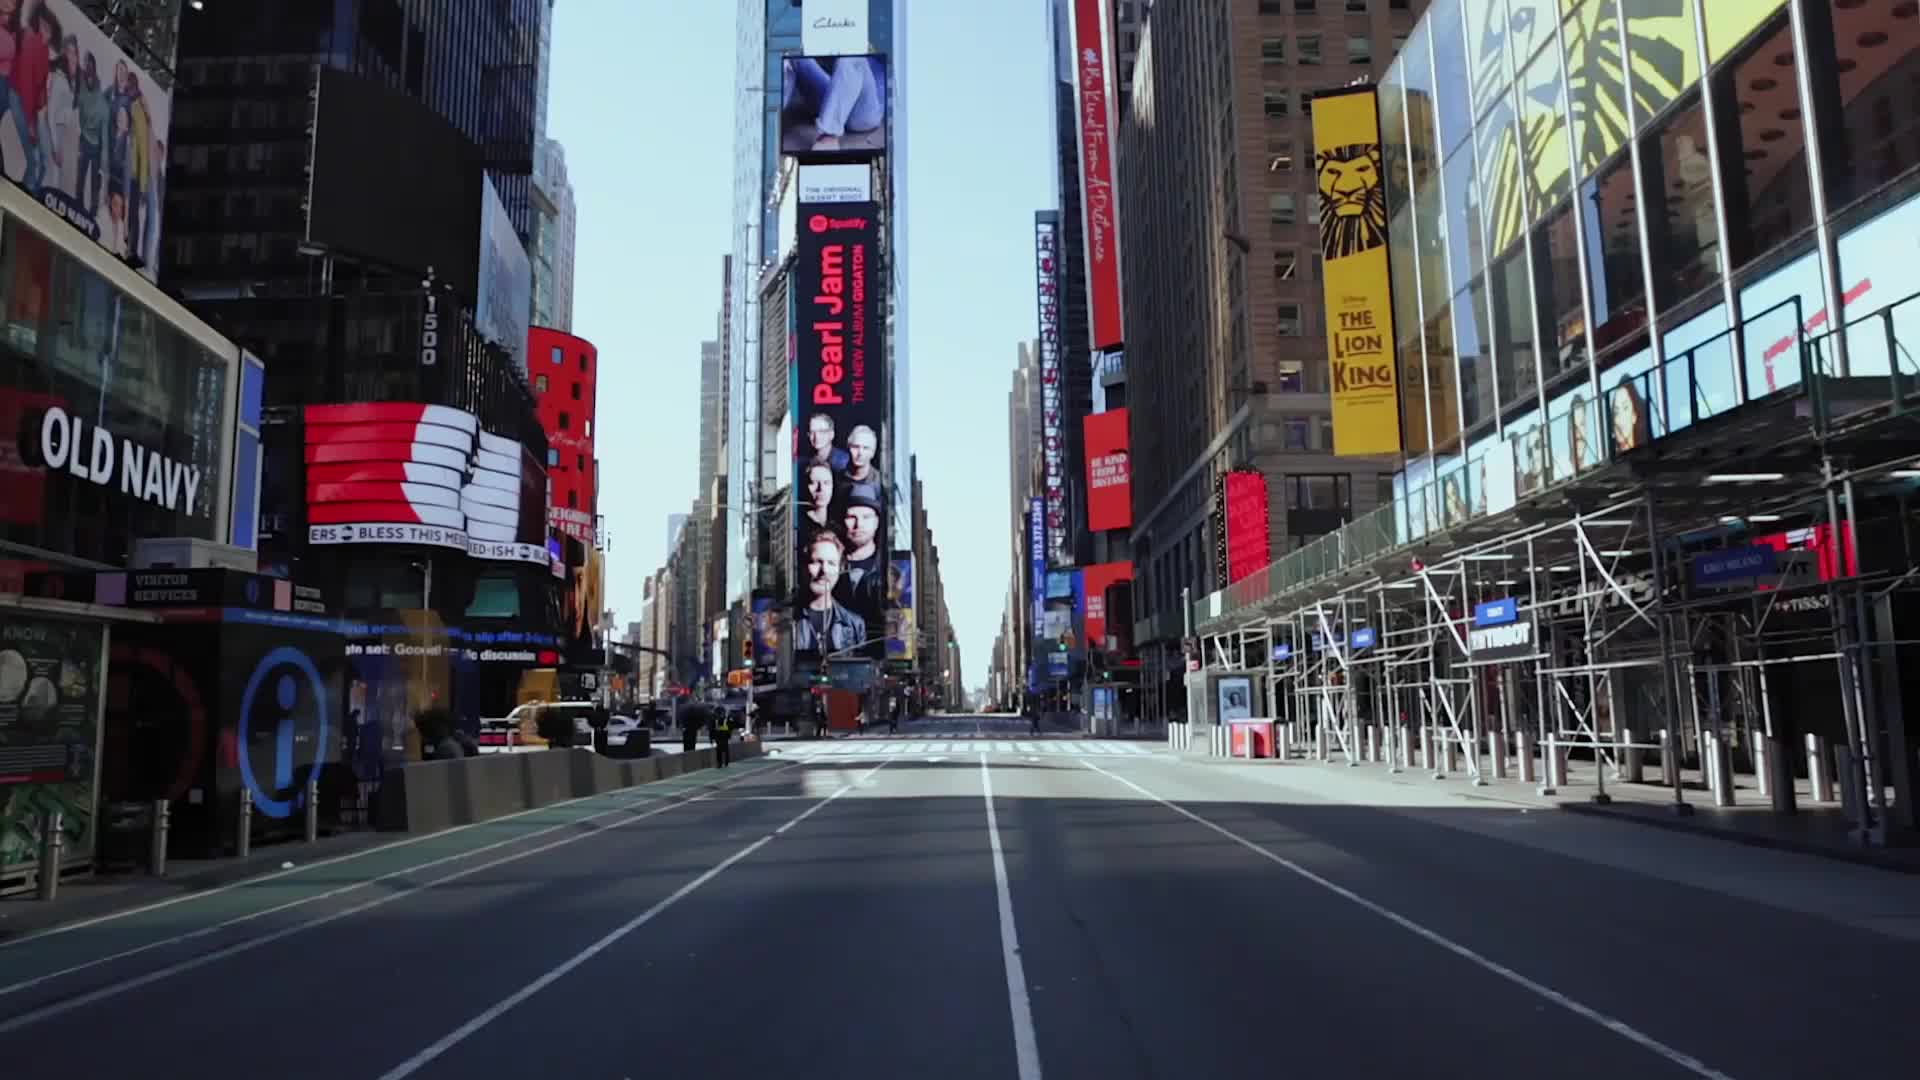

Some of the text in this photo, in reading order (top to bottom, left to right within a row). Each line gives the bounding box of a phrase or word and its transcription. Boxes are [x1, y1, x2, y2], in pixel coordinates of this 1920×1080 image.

[44, 192, 97, 237] OLD NAVY
[828, 218, 867, 231] Spotify
[422, 295, 438, 366] 1500
[813, 244, 844, 405] Pearl Jam
[852, 244, 865, 403] THE NEW ALBUM GIGATON
[1337, 310, 1374, 328] THE
[1334, 333, 1383, 359] LION
[1332, 362, 1392, 393] KING
[41, 406, 201, 517] OLD NAVY
[310, 528, 337, 541] ERS
[359, 527, 404, 539] BLESS
[409, 527, 442, 542] THIS
[135, 574, 188, 586] VISITOR
[133, 589, 198, 601] SERVICES
